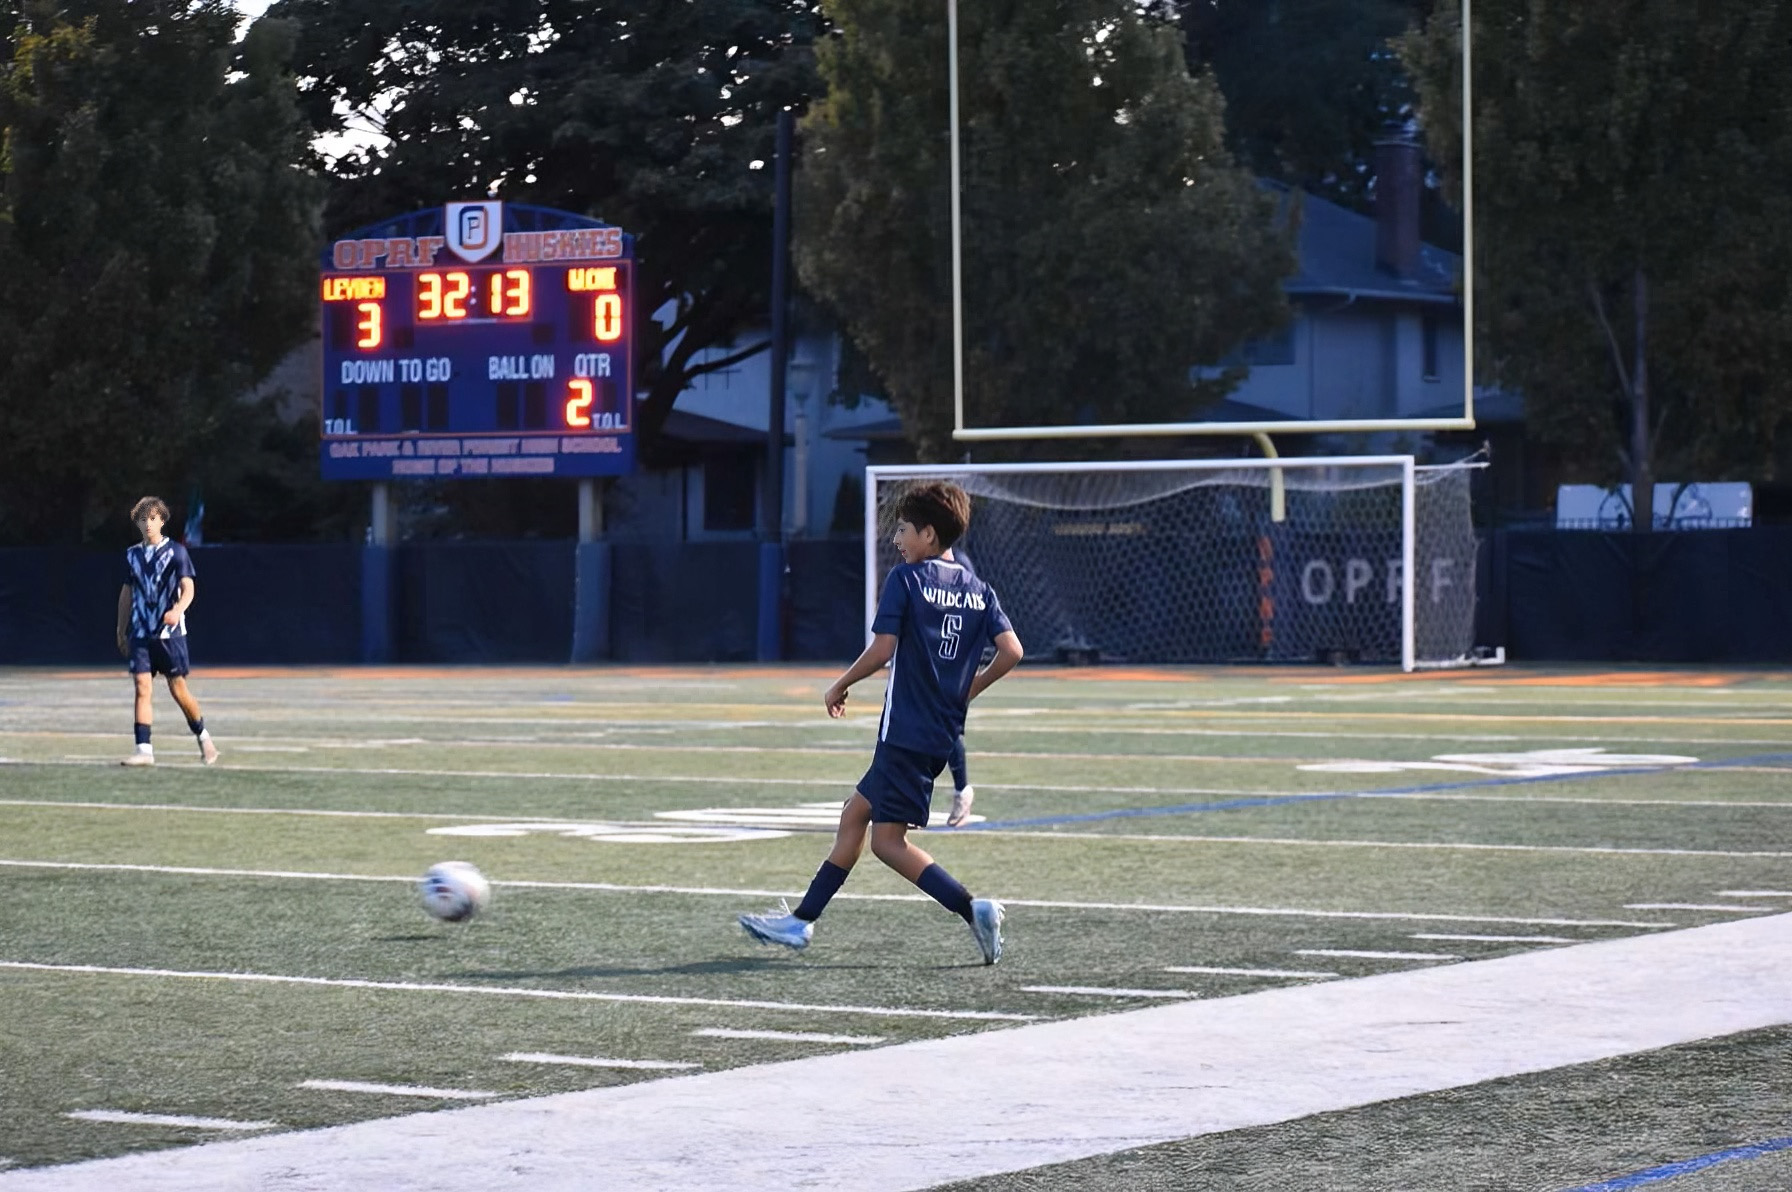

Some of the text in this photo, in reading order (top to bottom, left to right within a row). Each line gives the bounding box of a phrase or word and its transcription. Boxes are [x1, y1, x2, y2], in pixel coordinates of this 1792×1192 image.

[333, 236, 445, 269] OPRF
[418, 269, 530, 319] 32:13
[358, 302, 381, 348] 3
[595, 294, 621, 341] 0
[341, 357, 451, 384] DOWN TO GO
[488, 354, 554, 380] BALL ON
[574, 353, 610, 378] QTR
[566, 379, 592, 426] 2
[922, 587, 986, 610] WILDCATS
[938, 613, 962, 660] 5
